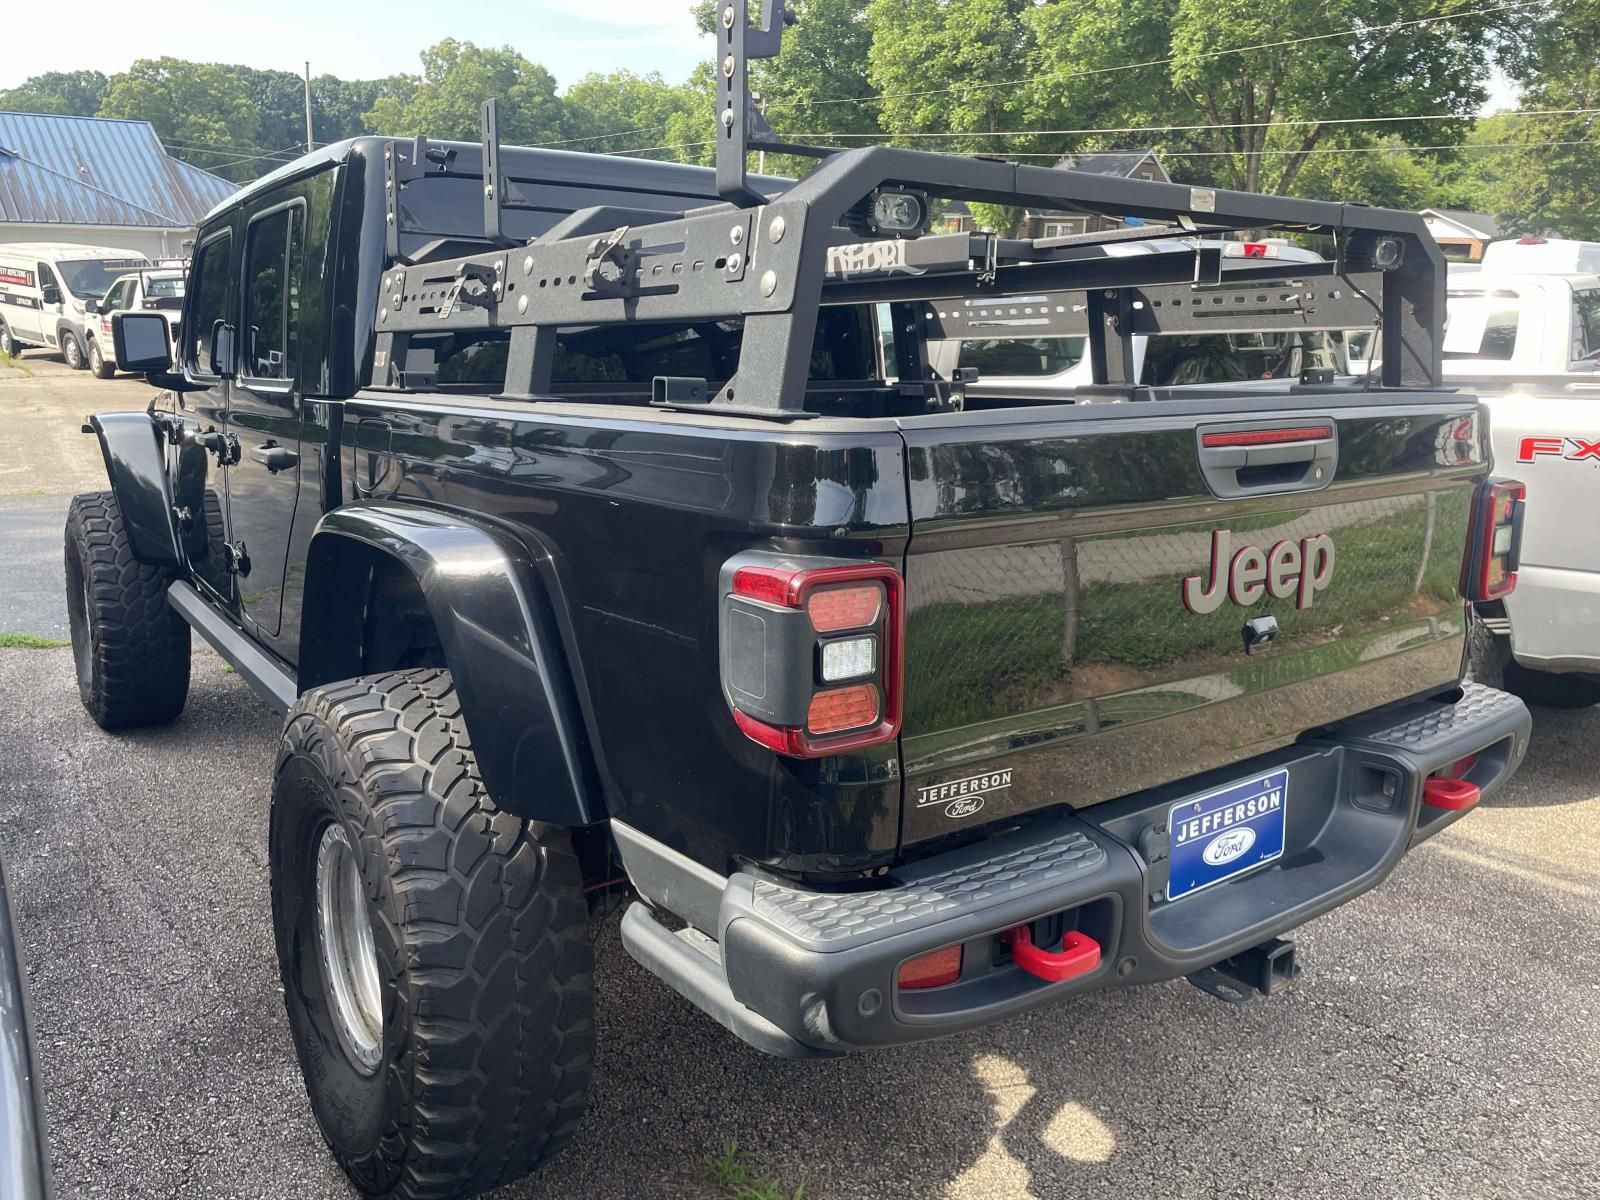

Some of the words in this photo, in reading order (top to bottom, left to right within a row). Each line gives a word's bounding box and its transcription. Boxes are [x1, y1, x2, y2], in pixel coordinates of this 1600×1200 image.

[1183, 528, 1335, 615] Jeep
[918, 771, 1012, 804] JEFFERSON
[951, 799, 978, 816] Ford
[1177, 790, 1280, 842] JEFFERSON
[1212, 833, 1247, 861] Ford
